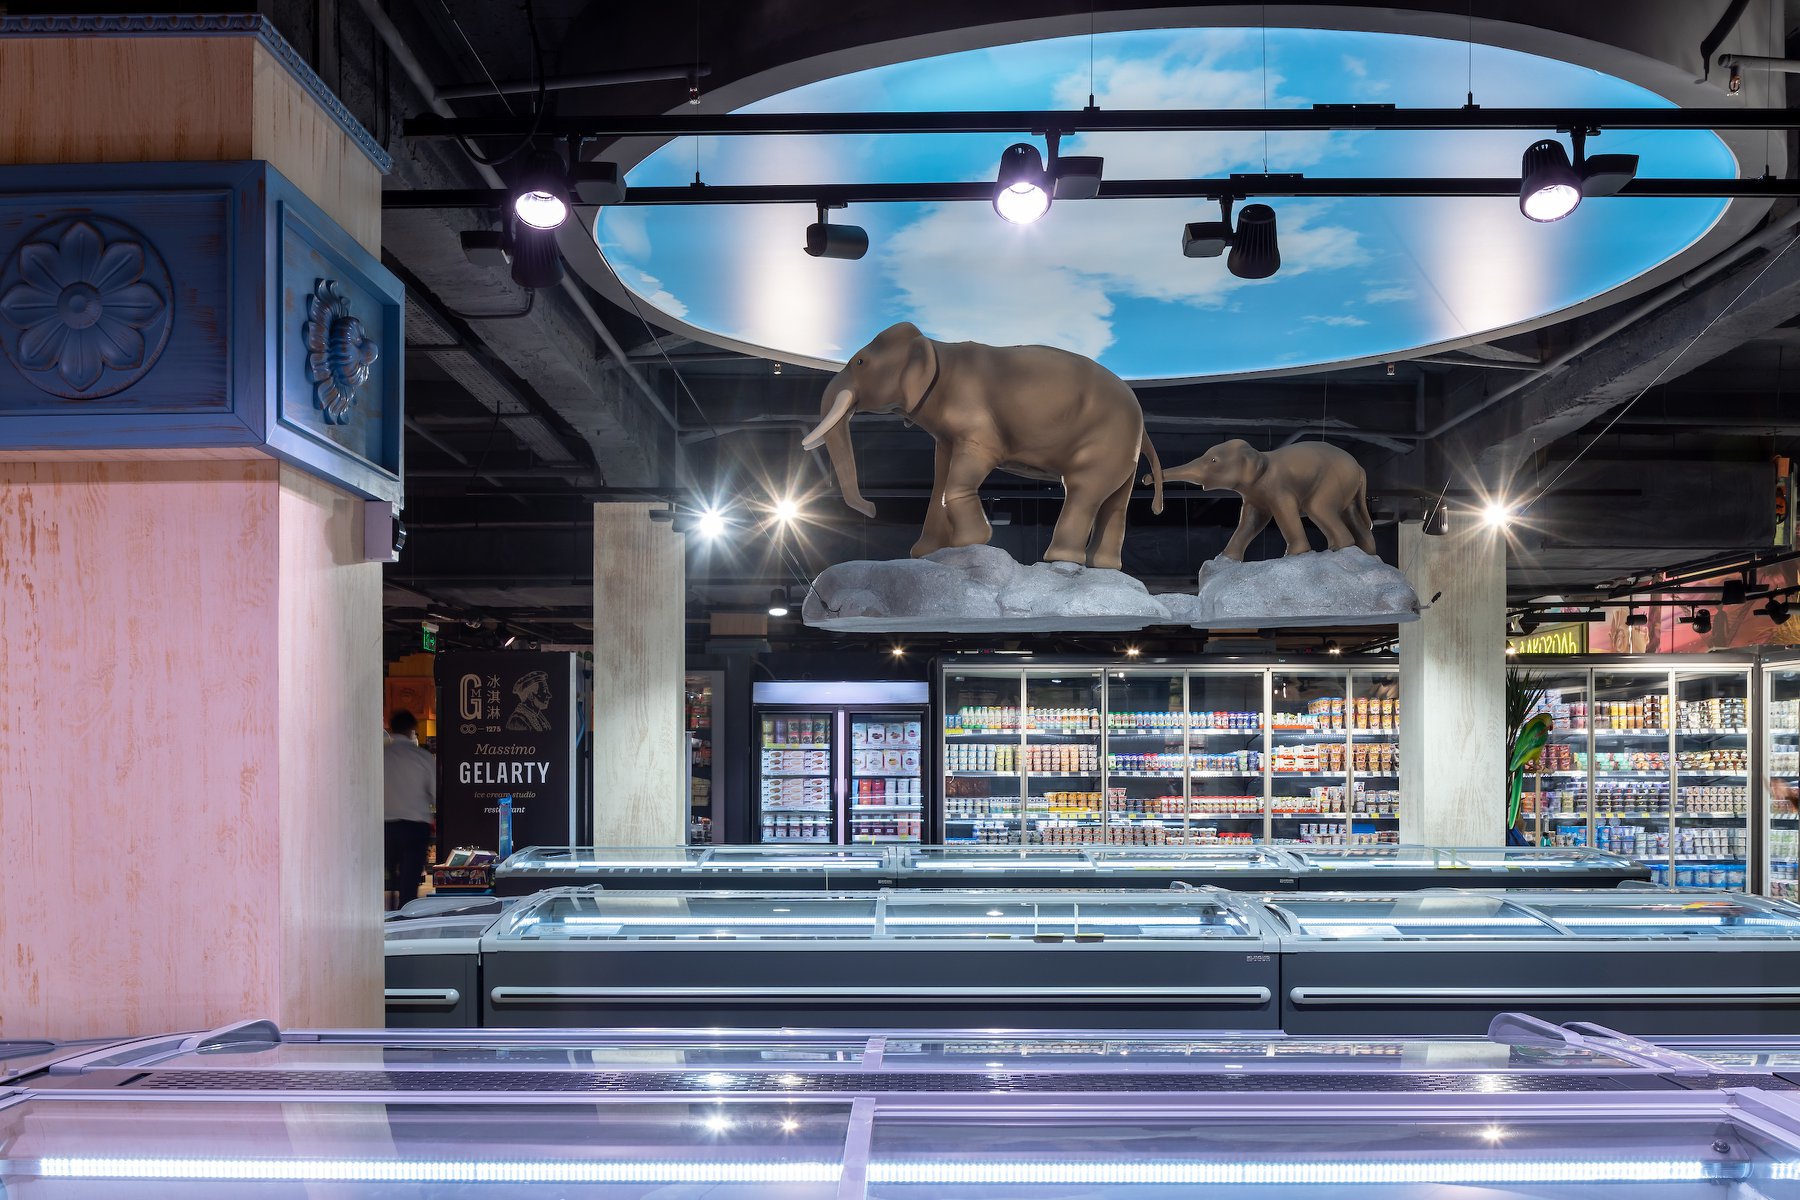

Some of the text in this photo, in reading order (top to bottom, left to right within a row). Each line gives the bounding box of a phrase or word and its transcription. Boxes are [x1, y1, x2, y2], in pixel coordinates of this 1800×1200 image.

[486, 674, 501, 720] 冰淇淋
[485, 725, 501, 733] 1275
[474, 743, 536, 755] Massimo
[459, 761, 550, 784] GELARTY
[474, 791, 486, 799] ice
[512, 790, 536, 799] studio
